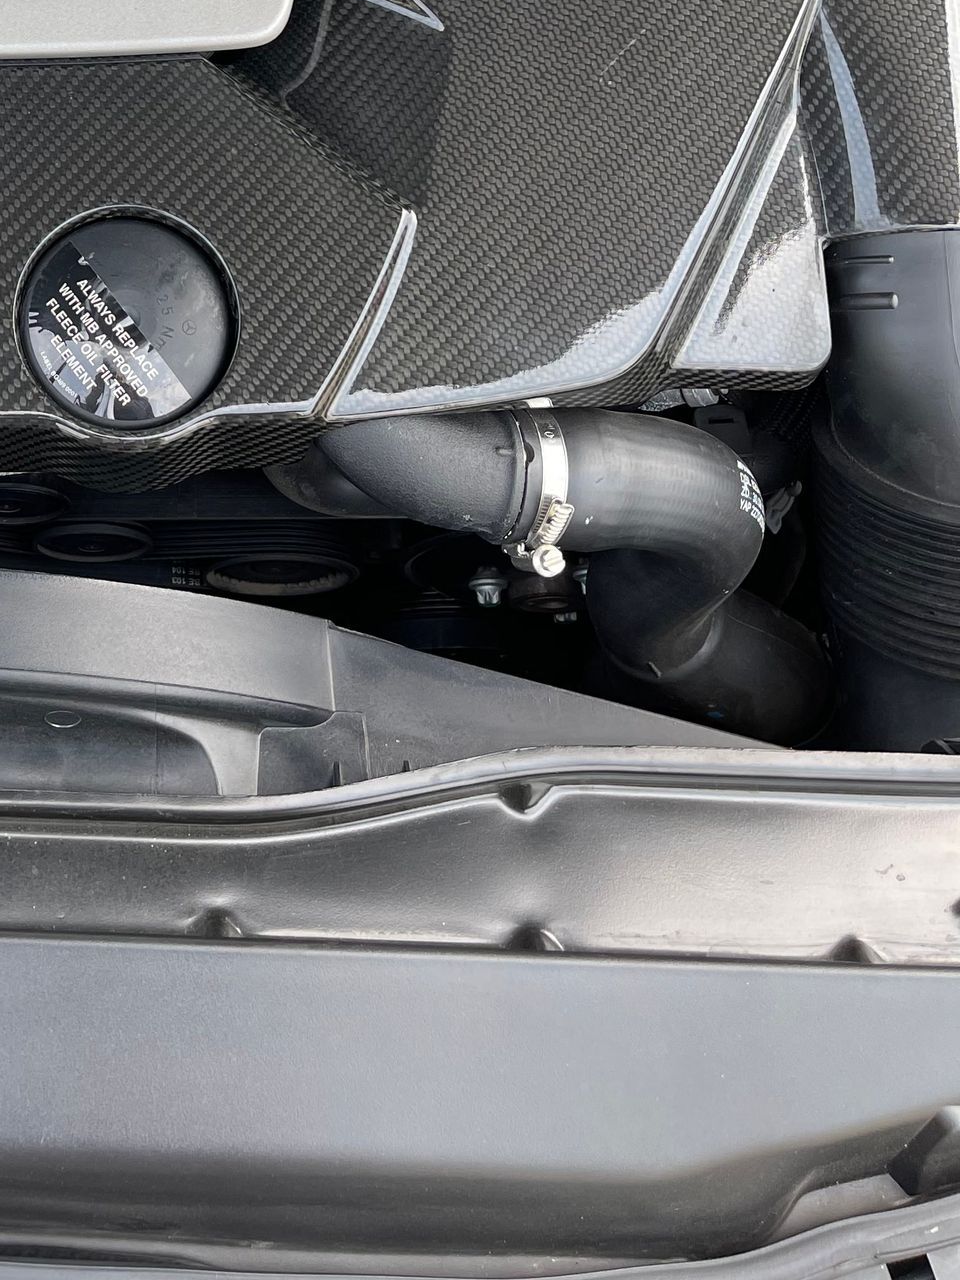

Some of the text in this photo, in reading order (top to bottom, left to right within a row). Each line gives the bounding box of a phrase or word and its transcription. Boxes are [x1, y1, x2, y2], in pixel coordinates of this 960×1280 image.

[46, 297, 132, 407] FLEECE OIL FILTER
[50, 335, 97, 391] ELEMENT
[58, 283, 149, 398] WITH MB APPROVED
[76, 278, 159, 381] ALWAYS REPLACE
